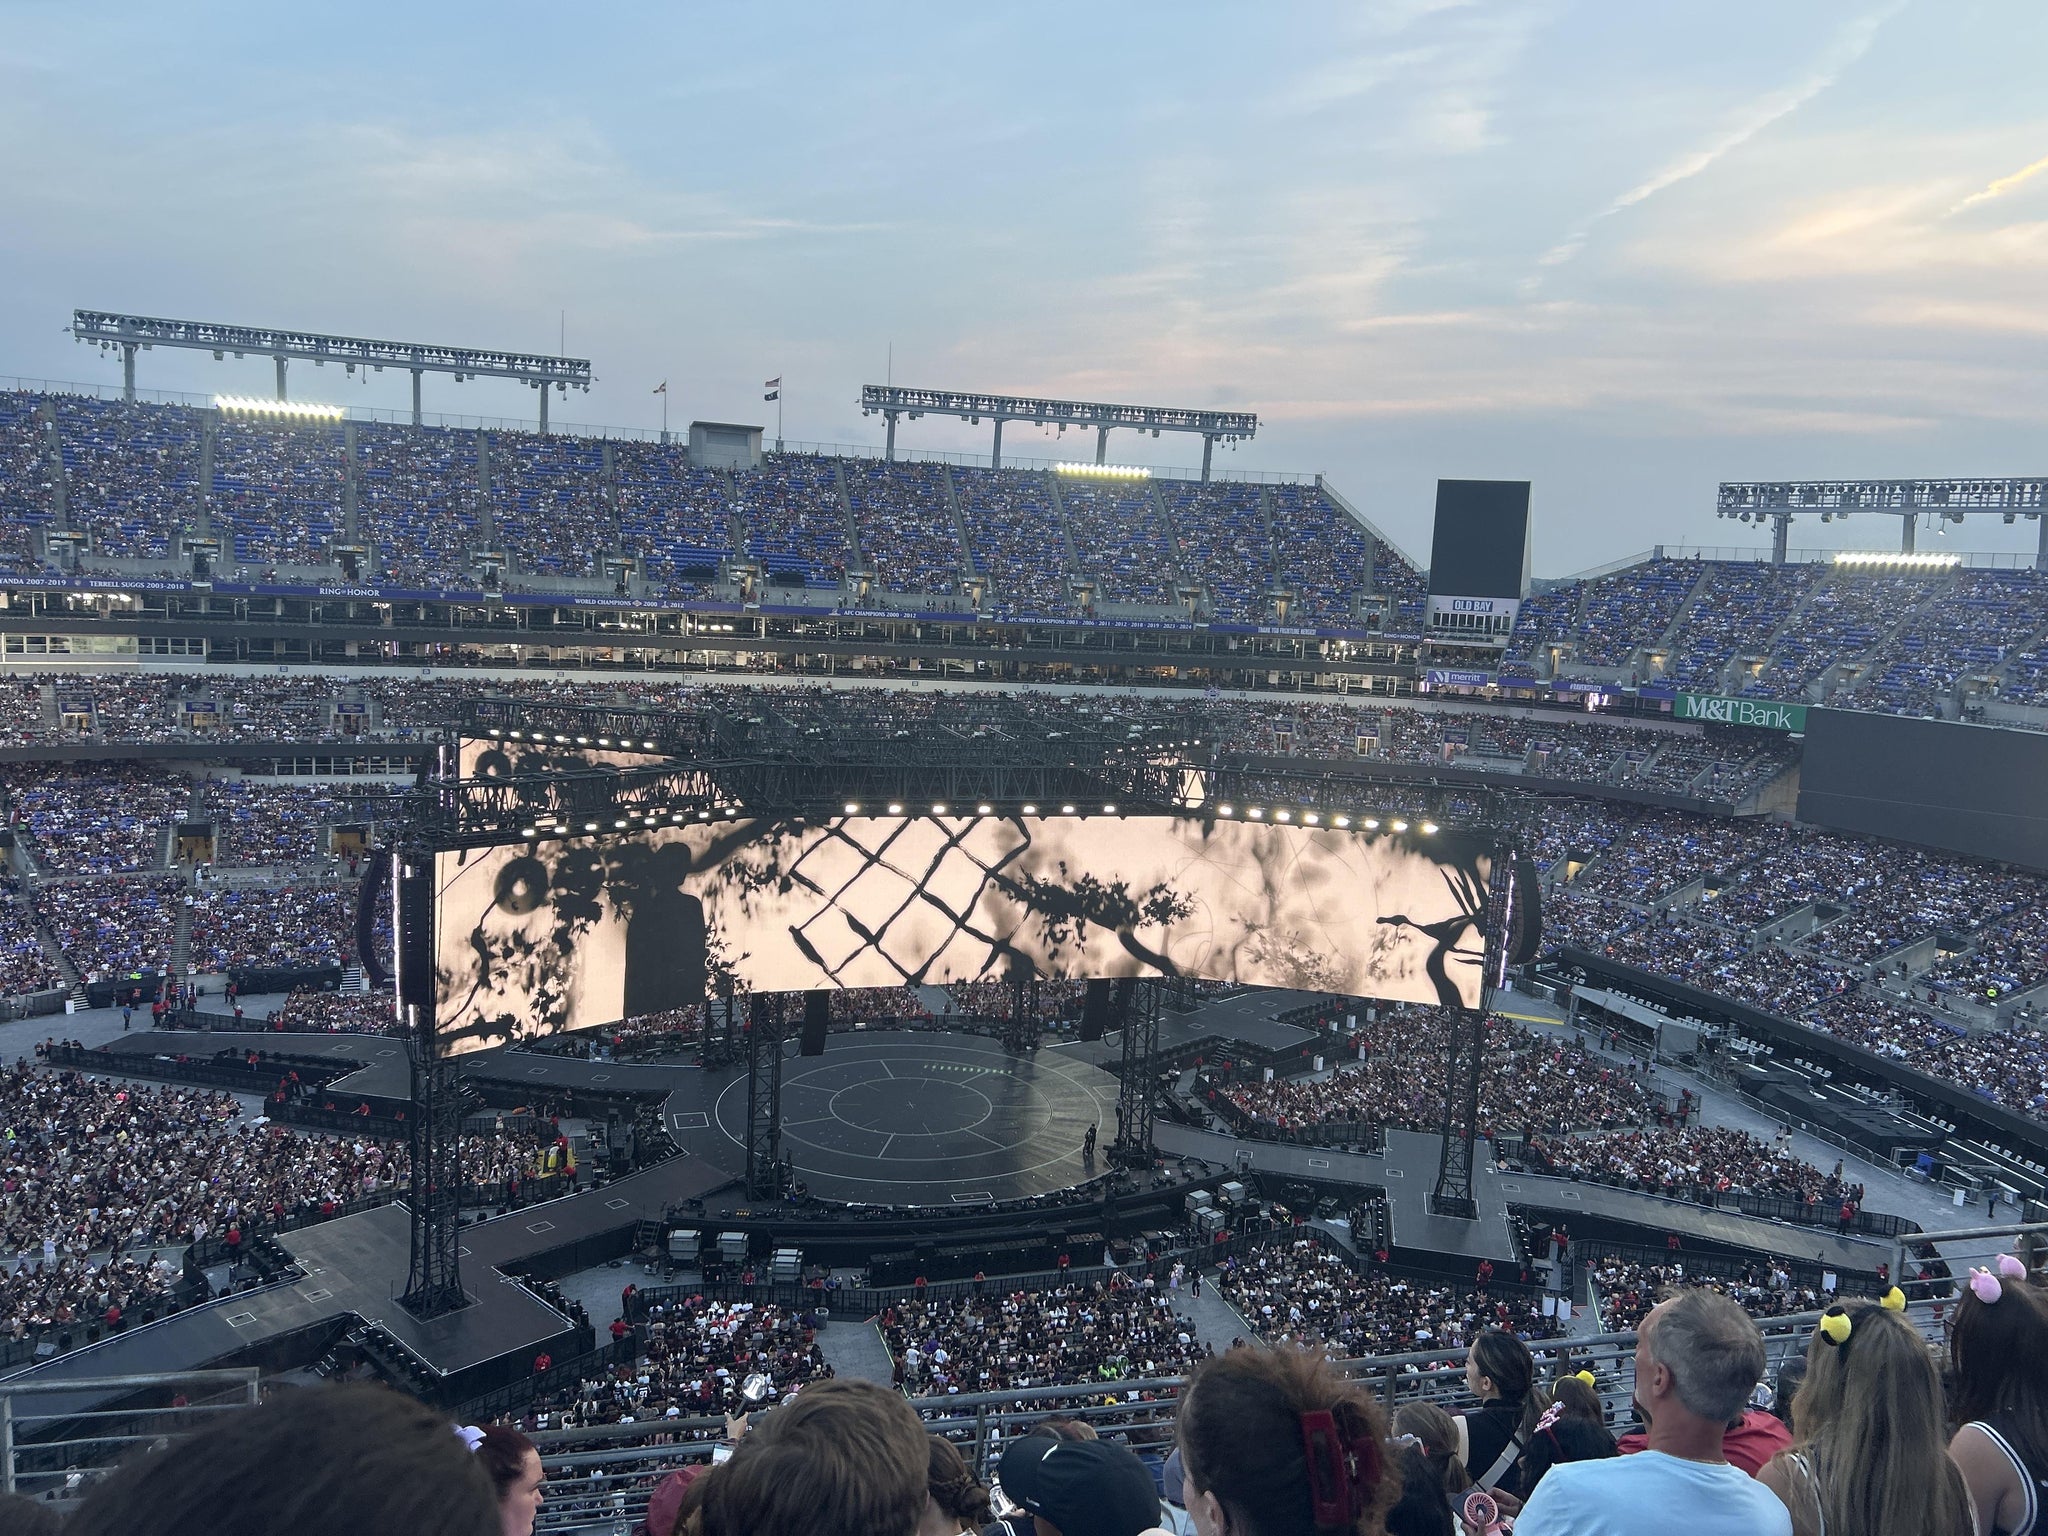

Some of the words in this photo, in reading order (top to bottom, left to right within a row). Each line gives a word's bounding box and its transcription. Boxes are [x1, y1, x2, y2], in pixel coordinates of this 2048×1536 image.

[26, 578, 67, 586] 2007-2019
[146, 582, 185, 590] 2003-2018
[320, 587, 341, 595] RING
[347, 589, 380, 597] HONOR
[1454, 600, 1472, 610] OLD
[1474, 601, 1491, 611] BAY
[1036, 617, 1066, 625] CHAMPIONS
[1451, 673, 1481, 682] merritt
[1685, 695, 1739, 722] M&T
[1739, 701, 1791, 729] Bank
